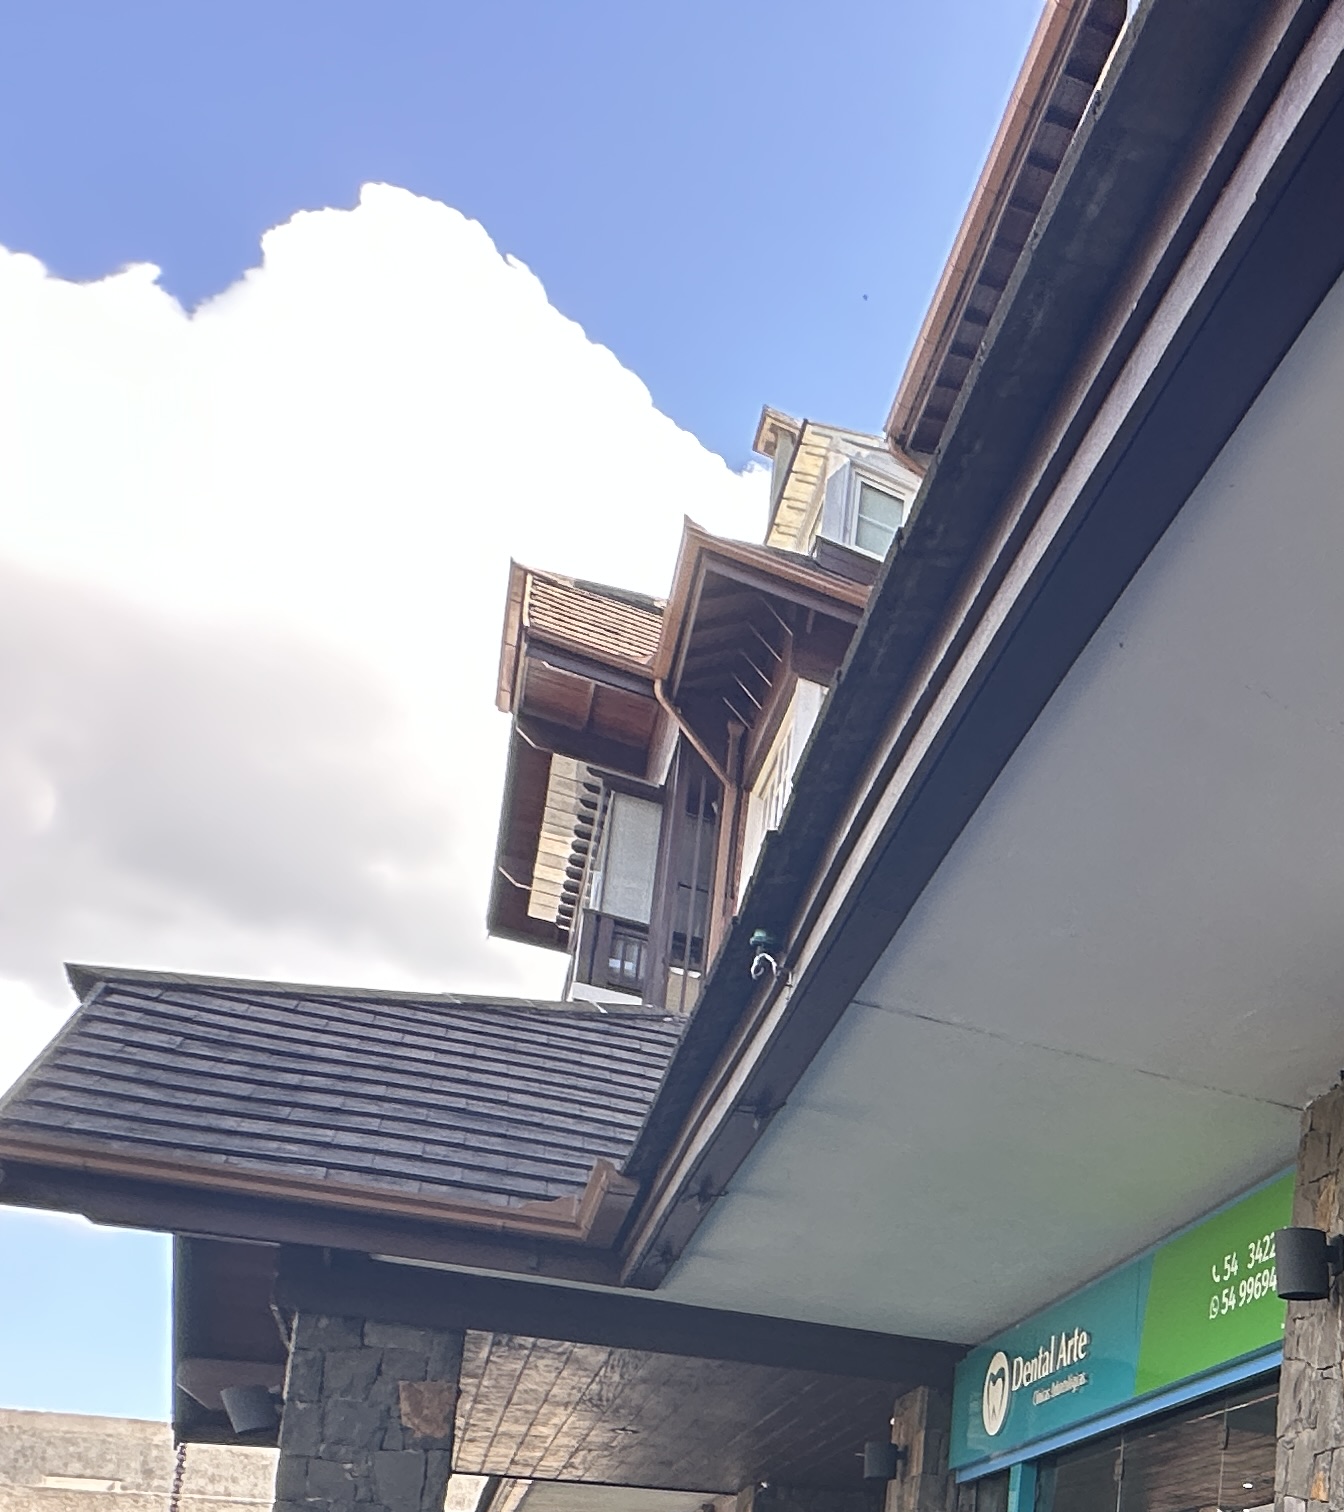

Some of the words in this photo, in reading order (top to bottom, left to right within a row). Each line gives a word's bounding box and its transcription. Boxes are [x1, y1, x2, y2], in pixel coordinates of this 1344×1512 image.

[1223, 1251, 1239, 1281] 54
[1221, 1285, 1236, 1315] 54
[1012, 1335, 1056, 1392] Dental
[1056, 1327, 1088, 1370] Arte
